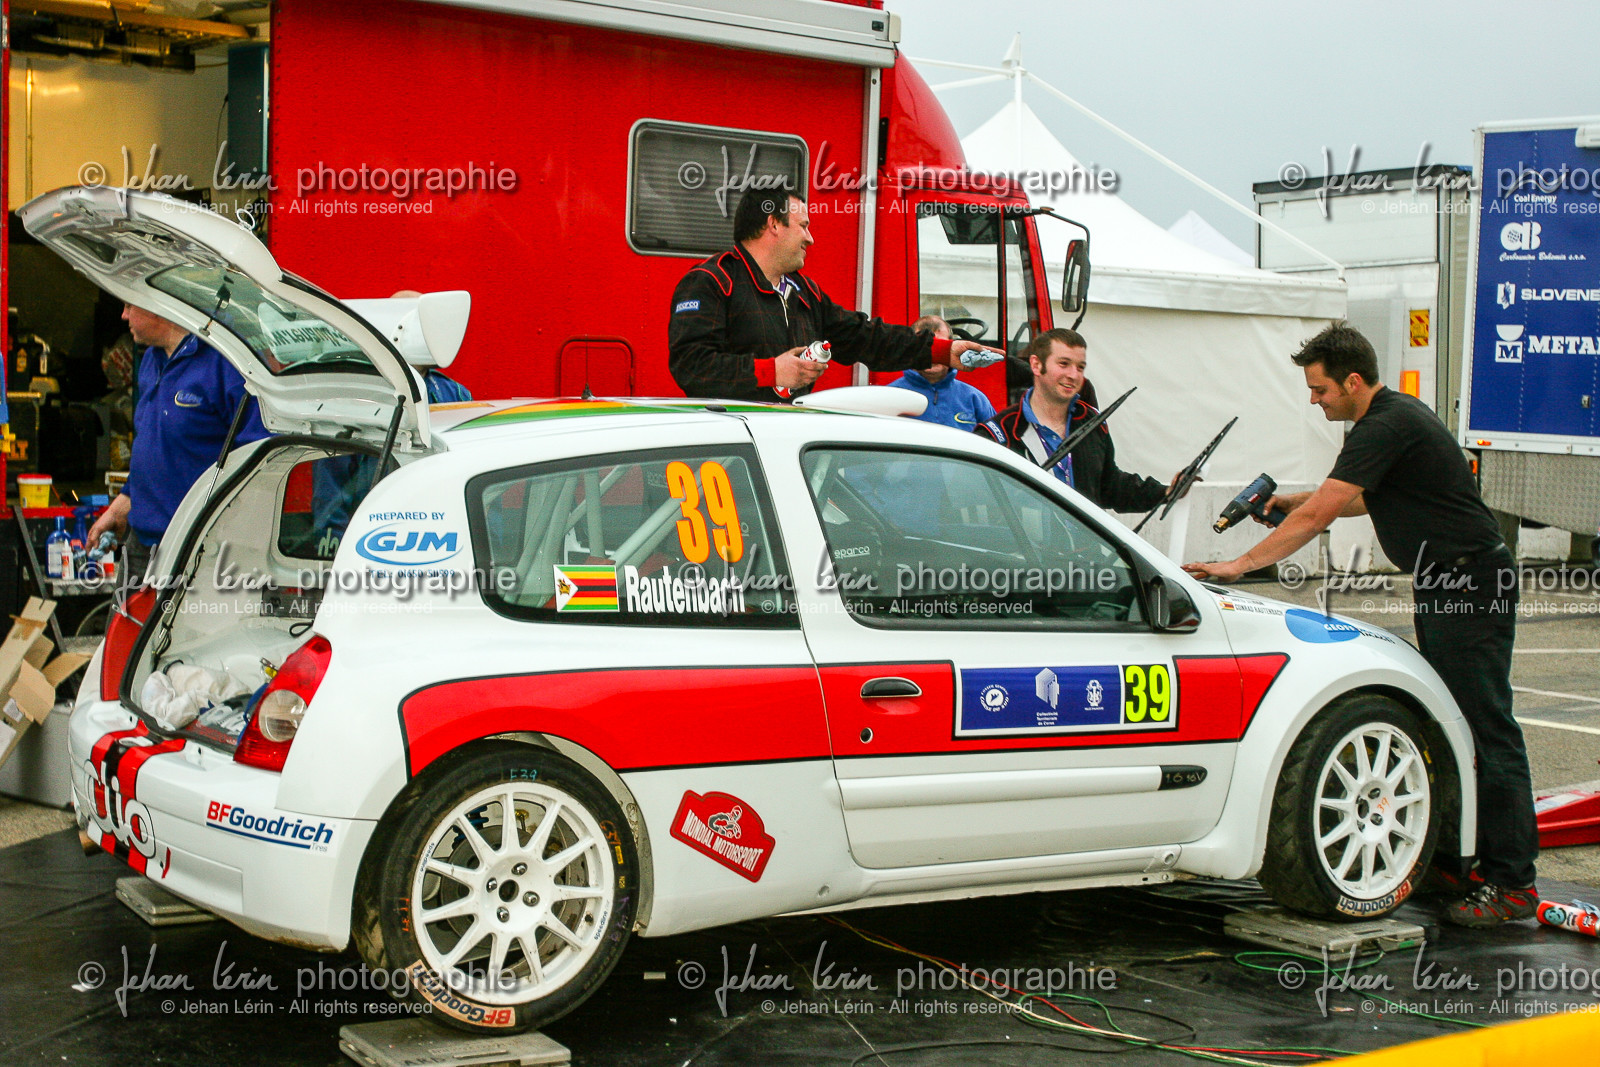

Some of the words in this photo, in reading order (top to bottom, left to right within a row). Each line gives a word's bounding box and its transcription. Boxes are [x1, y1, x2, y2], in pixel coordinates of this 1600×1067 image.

[1514, 194, 1531, 203] Coal
[1528, 335, 1600, 355] META
[369, 512, 427, 521] PREPARED
[431, 512, 445, 520] BY
[666, 461, 744, 564] 39
[367, 532, 457, 551] GJM
[624, 565, 746, 613] Rautenbach
[1125, 665, 1170, 722] 39
[207, 800, 333, 844] BFGoodrich
[681, 809, 715, 848] MONDIAL
[712, 835, 764, 872] MOTORSPORT
[311, 842, 328, 852] Tires
[1340, 881, 1410, 915] BFGoodrich
[413, 965, 512, 1025] BFGoodrich
